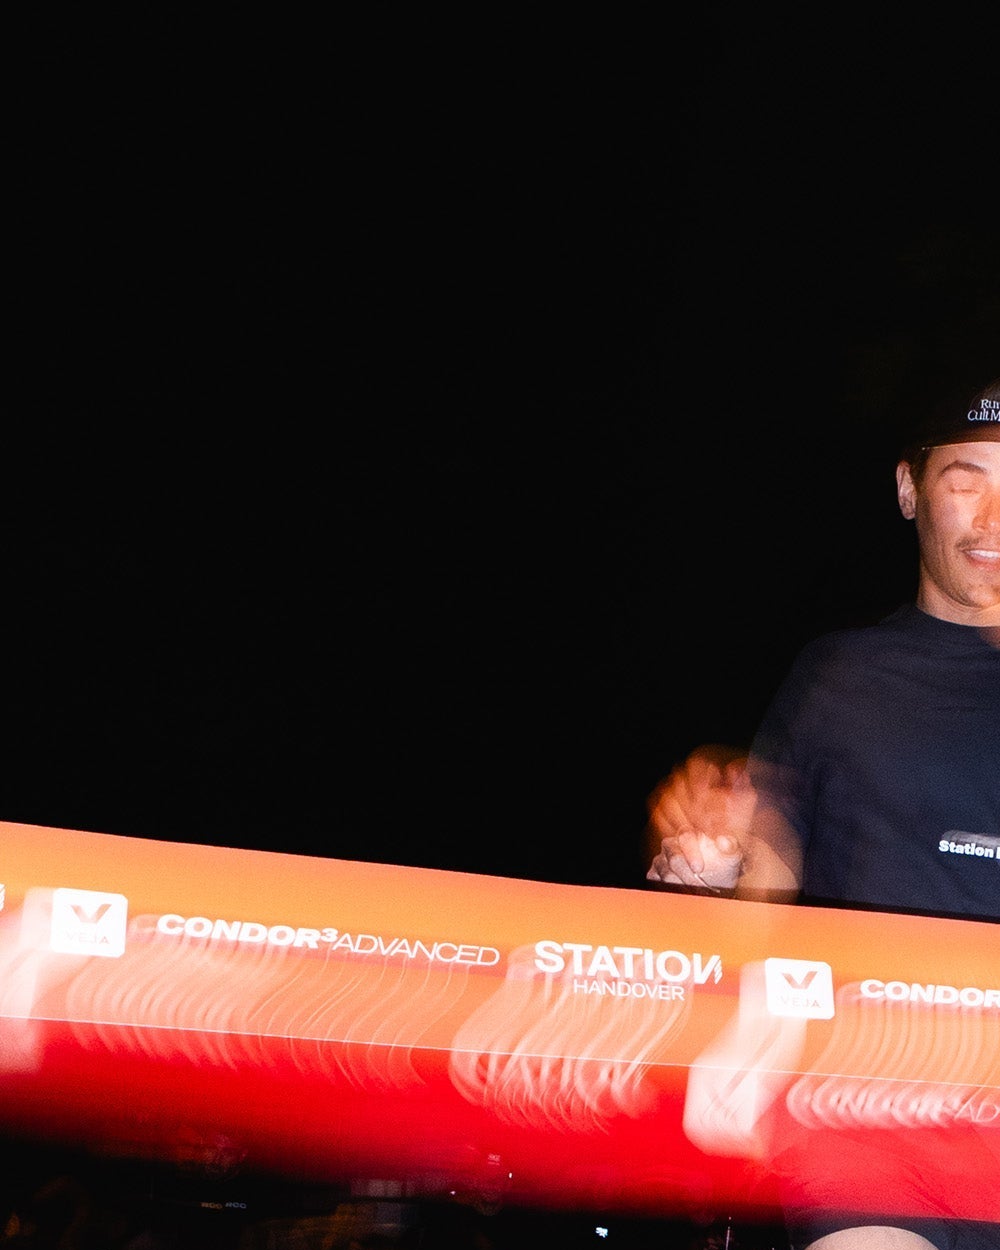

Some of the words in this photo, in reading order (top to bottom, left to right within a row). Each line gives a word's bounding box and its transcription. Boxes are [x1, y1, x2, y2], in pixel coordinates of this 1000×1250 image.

[967, 409, 990, 421] Cult
[938, 839, 994, 858] Station
[572, 978, 685, 1001] HANDOVER
